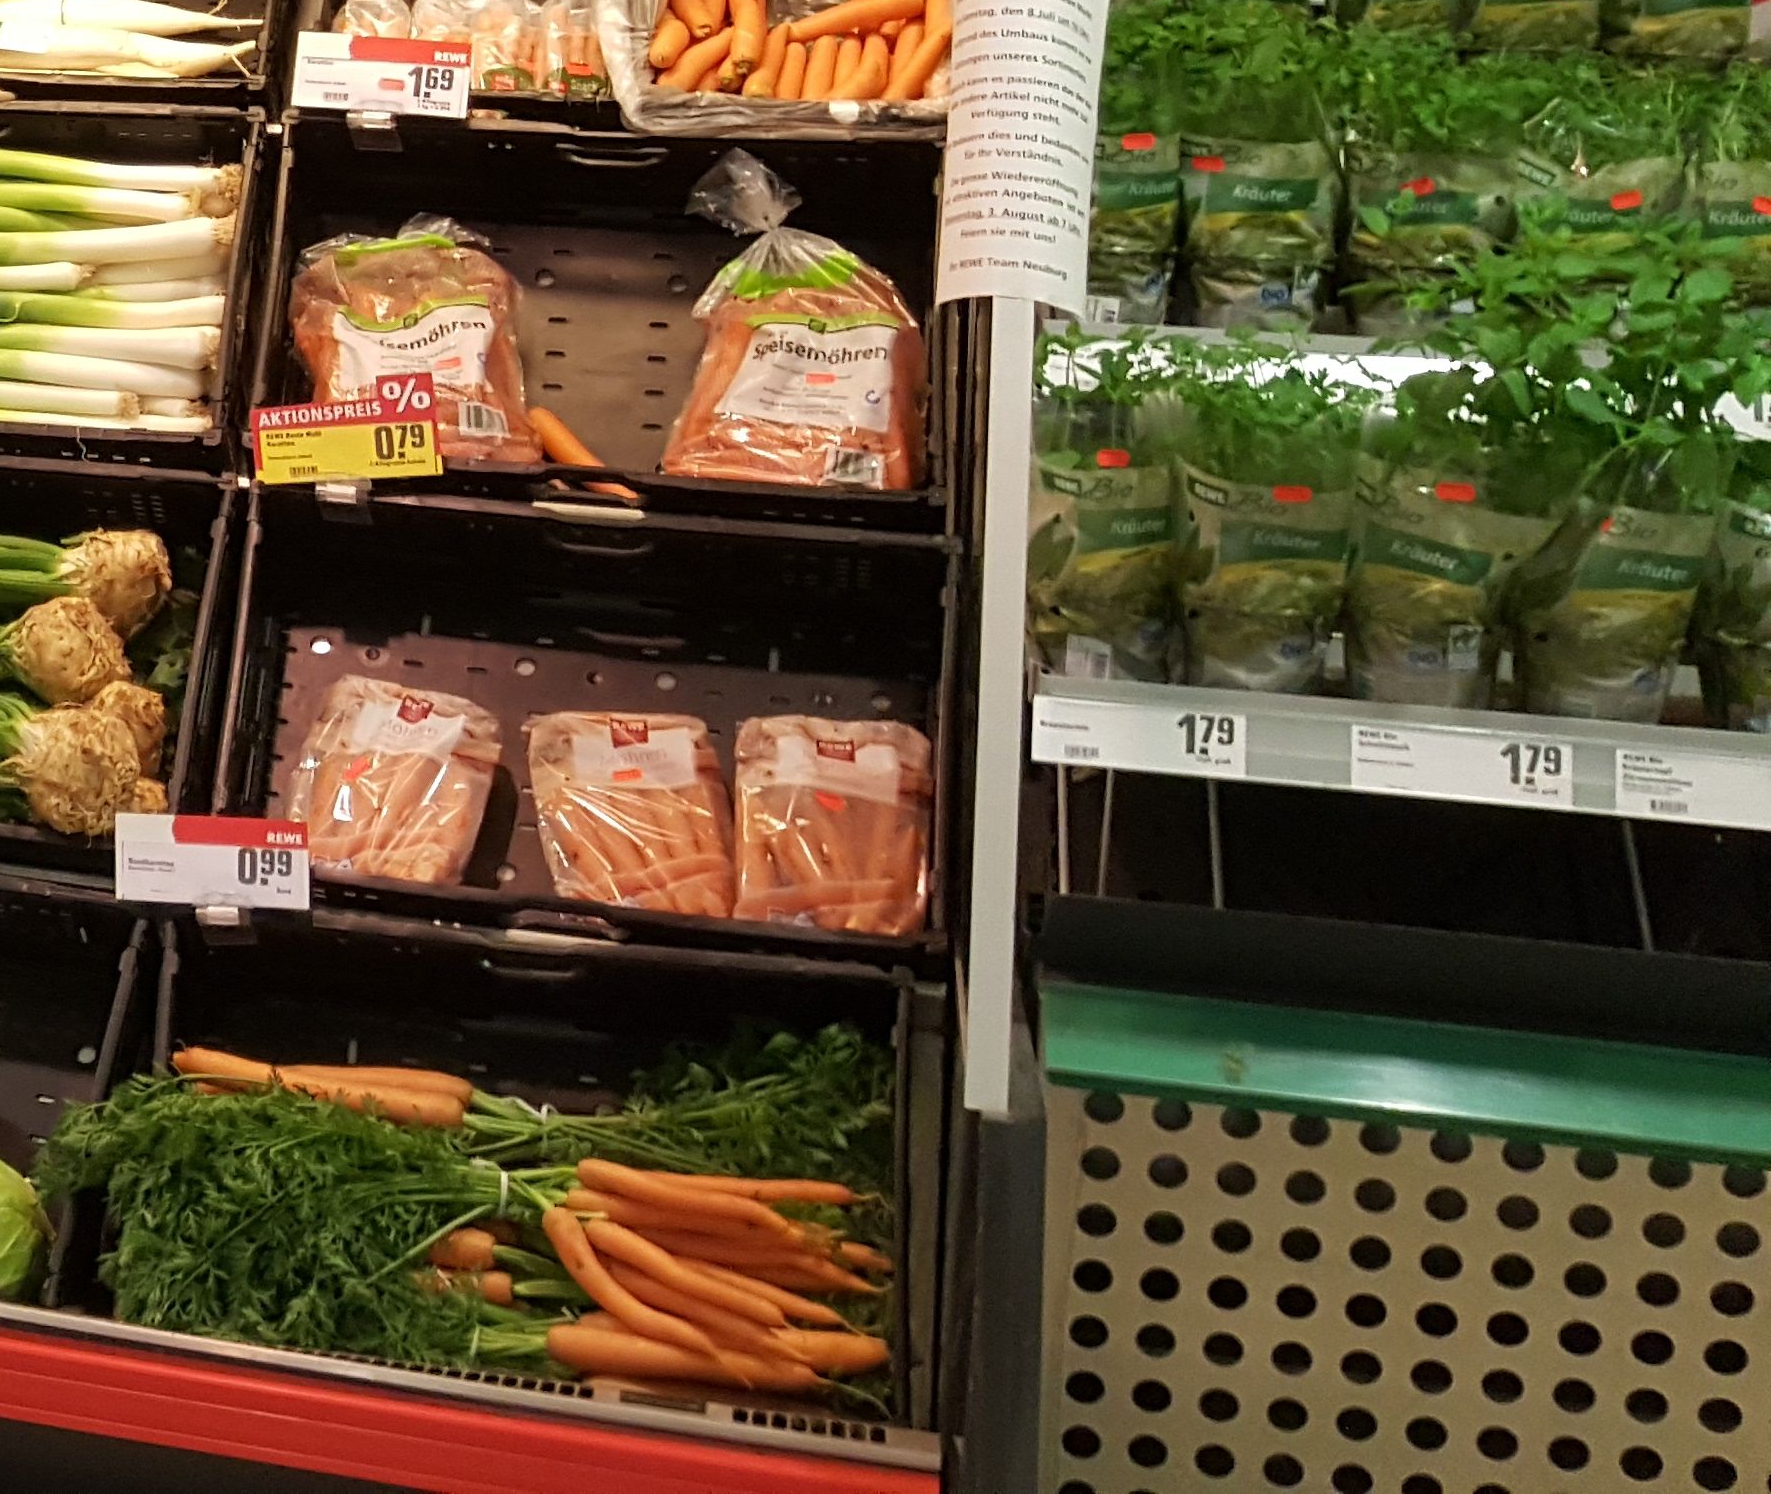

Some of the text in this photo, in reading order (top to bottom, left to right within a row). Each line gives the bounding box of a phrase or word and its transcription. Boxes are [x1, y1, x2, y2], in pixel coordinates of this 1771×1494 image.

[1001, 7, 1024, 16] den
[1001, 28, 1048, 42] Umbaus
[434, 51, 467, 63] REWE
[993, 55, 1038, 63] unseres
[408, 66, 454, 98] 1.69
[1007, 75, 1060, 90] passieren
[990, 90, 1059, 107] Artikel nicht
[987, 129, 1038, 144] dies und
[1232, 185, 1293, 205] Kräuter
[1001, 207, 1045, 223] August
[987, 257, 1019, 269] Team
[1022, 260, 1068, 281] Neuburg
[752, 338, 887, 365] Speisemöhren
[259, 377, 431, 428] AKTIONSPREIS %
[374, 424, 425, 460] 0.79
[1111, 518, 1166, 534] Kräuter
[1253, 531, 1322, 551] Kräuter
[1389, 539, 1459, 572] Kräuter
[1616, 556, 1690, 582] Kräuter
[1177, 712, 1236, 755] 1.79
[1500, 743, 1563, 786] 1.79
[266, 832, 303, 846] REWE
[237, 847, 293, 886] 0.99
